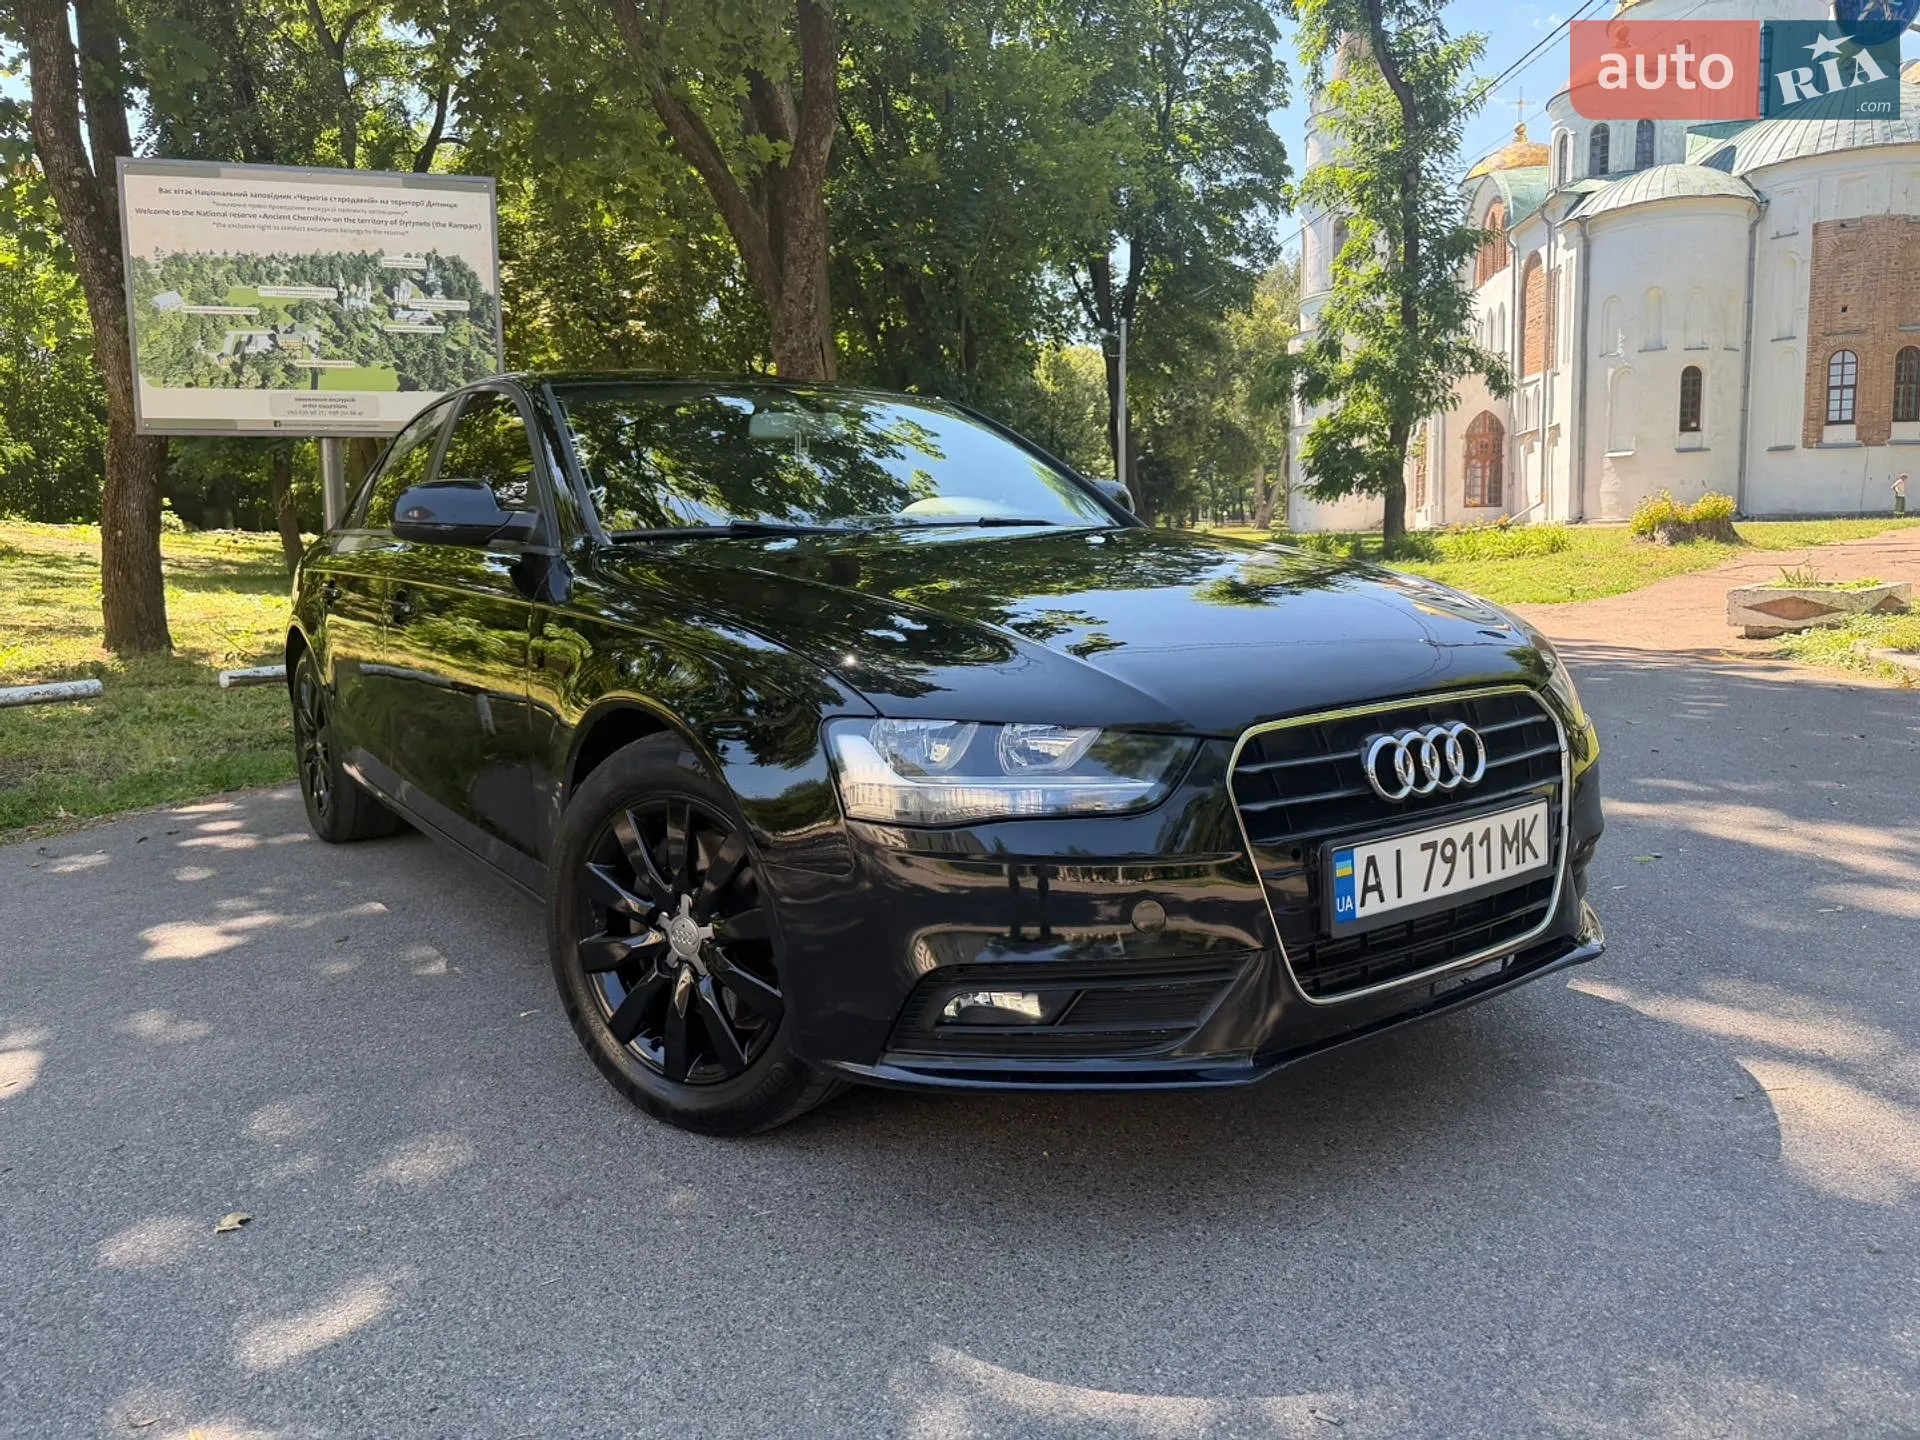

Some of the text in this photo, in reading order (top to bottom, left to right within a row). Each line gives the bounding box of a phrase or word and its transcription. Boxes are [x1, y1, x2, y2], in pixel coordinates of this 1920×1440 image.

[135, 207, 170, 216] Welcome
[182, 209, 194, 217] the
[196, 210, 228, 218] National
[344, 216, 356, 224] the
[358, 217, 388, 226] territory
[389, 218, 398, 226] of
[1360, 813, 1540, 909] AI 7911 MK
[1336, 895, 1353, 912] UA
